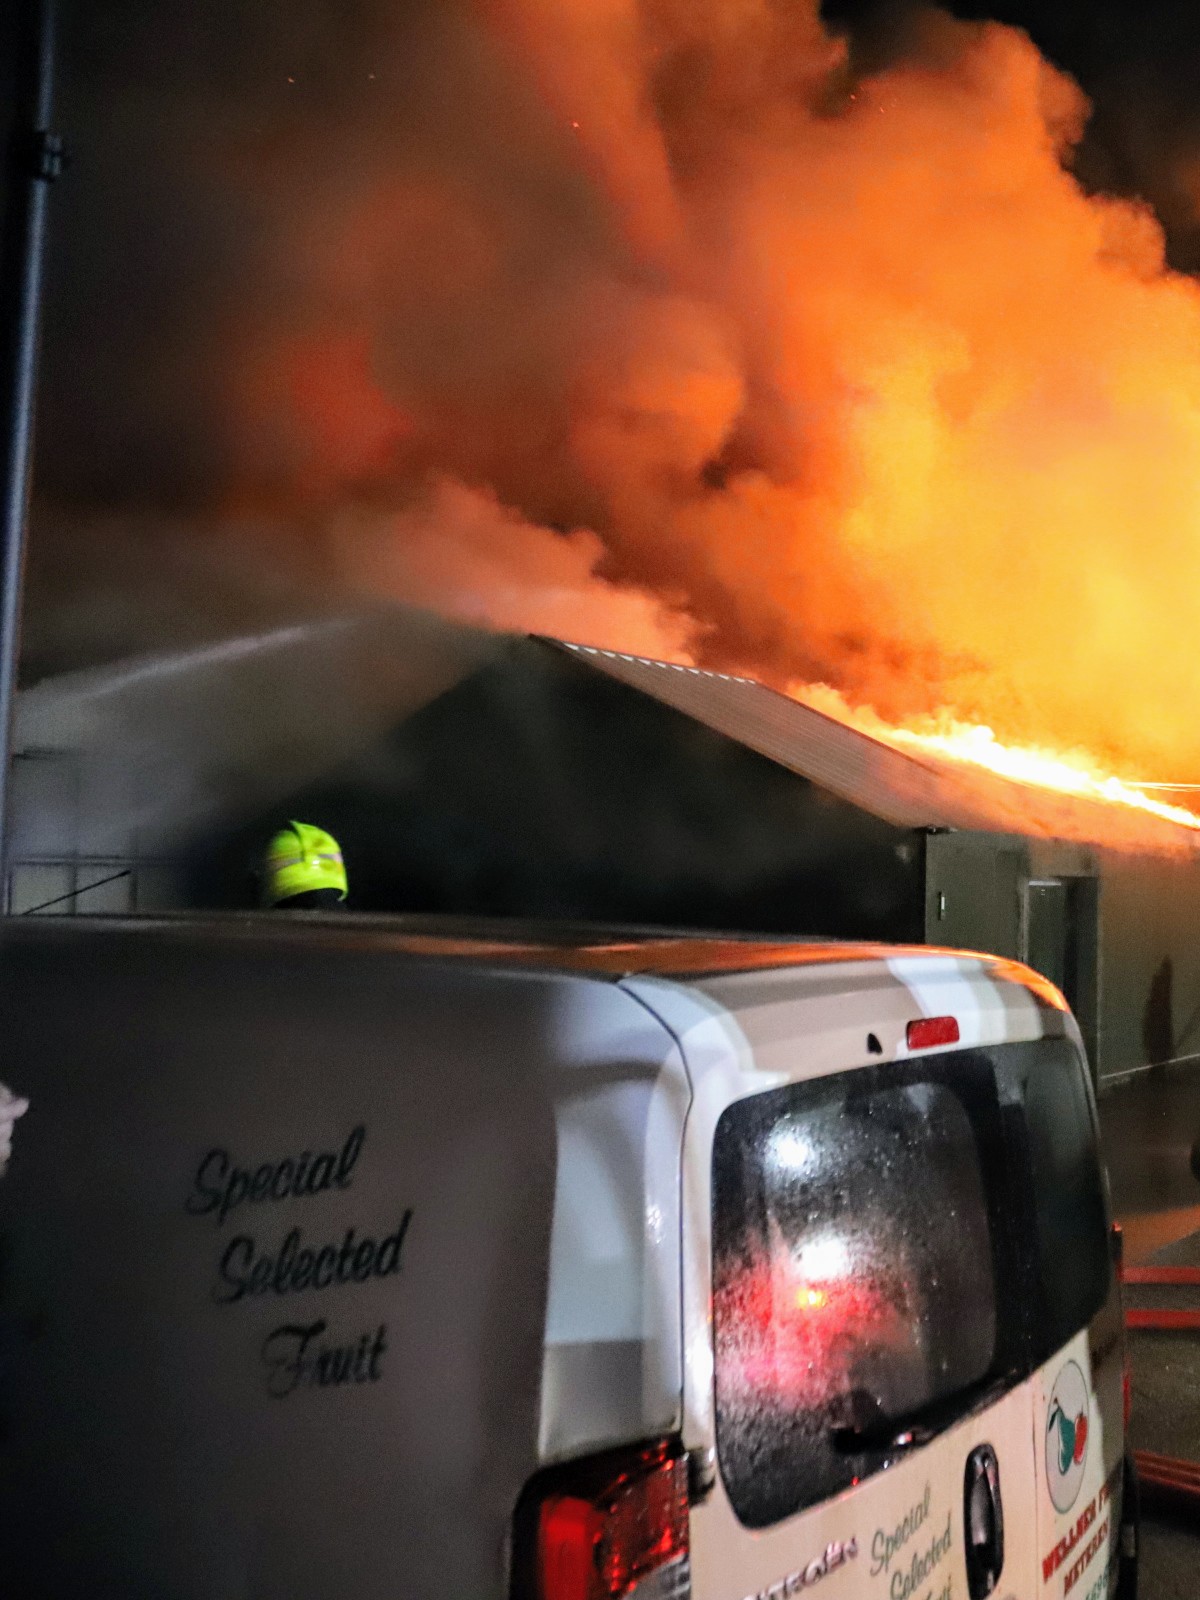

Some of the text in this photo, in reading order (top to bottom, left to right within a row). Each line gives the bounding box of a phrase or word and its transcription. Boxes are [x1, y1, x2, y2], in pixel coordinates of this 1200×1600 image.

[187, 1125, 365, 1224] Special
[215, 1209, 412, 1303] Selected
[259, 1319, 388, 1400] Fruit
[869, 1481, 931, 1577] Special
[890, 1509, 953, 1600] Selected
